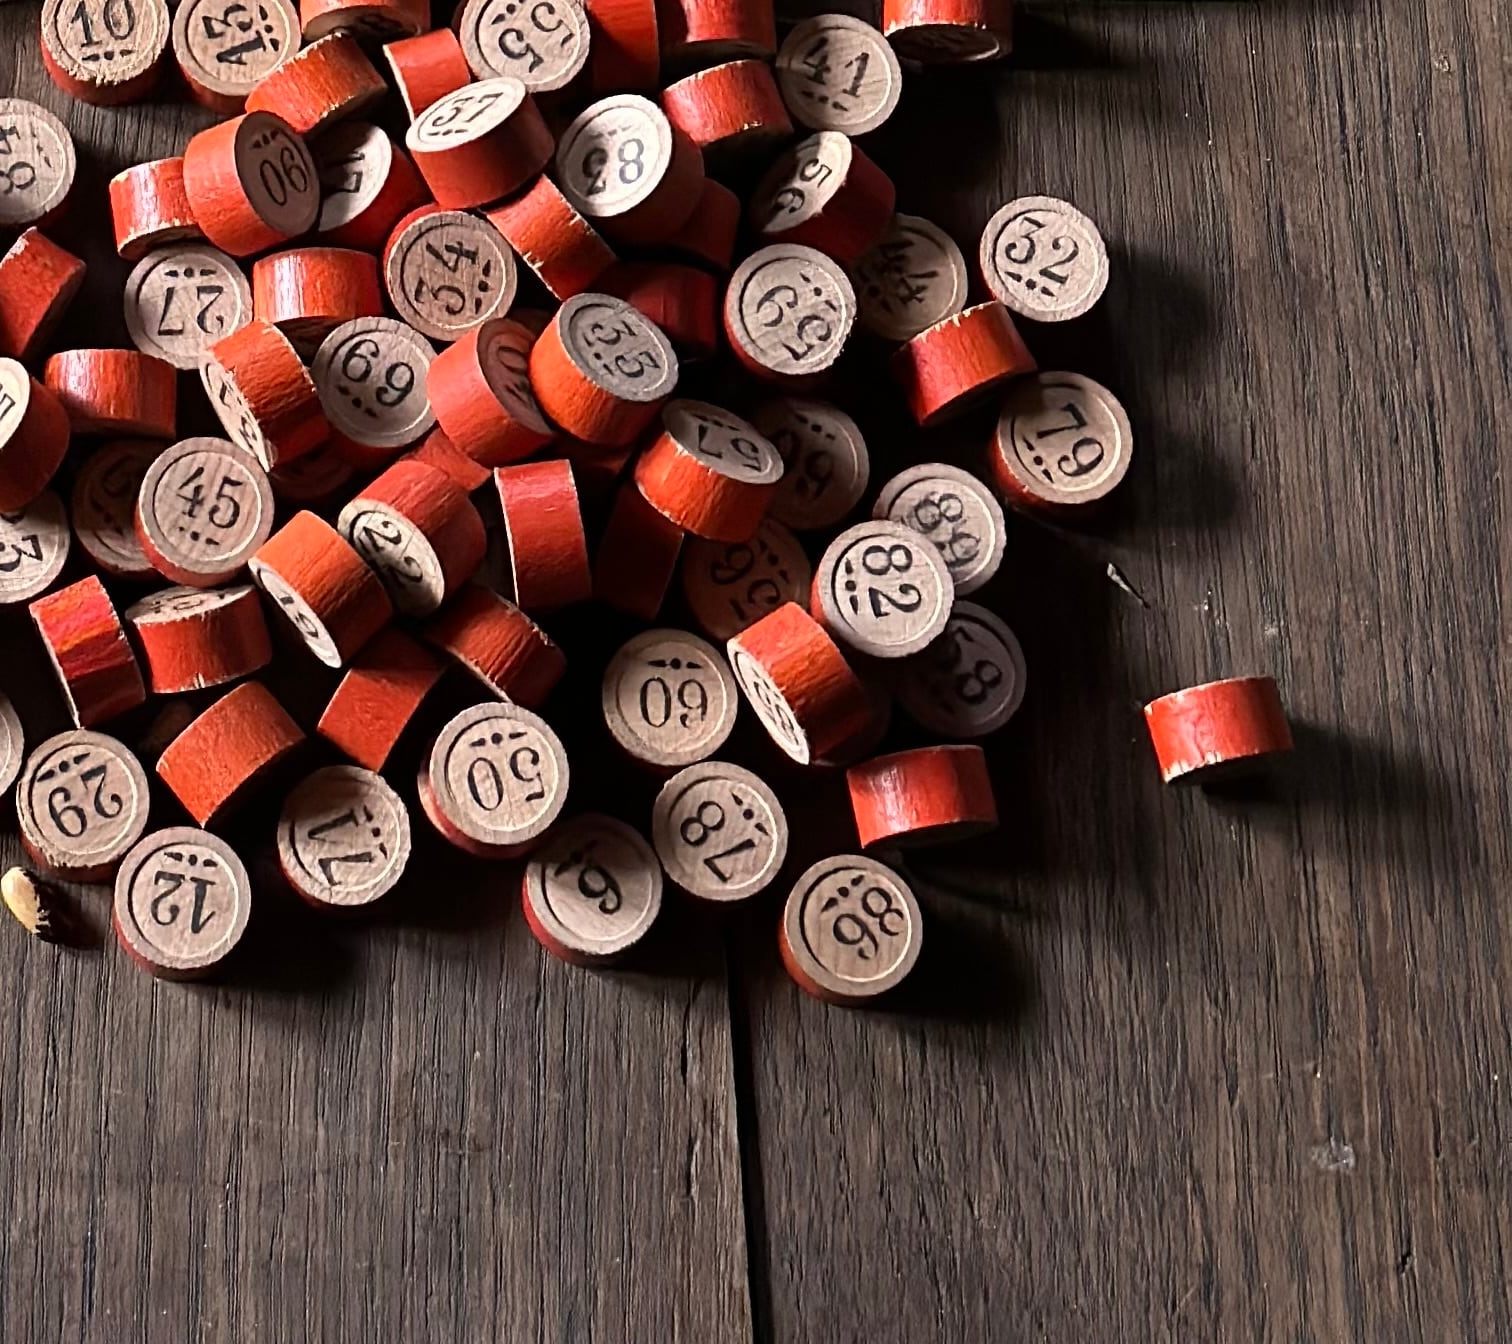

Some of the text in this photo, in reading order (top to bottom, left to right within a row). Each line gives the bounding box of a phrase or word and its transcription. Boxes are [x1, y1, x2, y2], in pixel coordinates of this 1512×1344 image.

[202, 2, 264, 65] 13
[497, 1, 575, 73] 55
[802, 36, 869, 97] 41
[583, 138, 644, 197] 83
[413, 240, 481, 314] 34
[1004, 217, 1079, 284] 32
[157, 284, 224, 337] 27
[756, 286, 831, 361] 59
[341, 339, 415, 407] 69
[699, 424, 761, 472] 57
[1038, 403, 1105, 478] 79
[176, 466, 244, 529] 45
[363, 521, 423, 584] 22
[861, 543, 923, 620] 82
[638, 676, 708, 729] 60
[48, 765, 123, 837] 29
[467, 747, 546, 811] 50
[307, 808, 373, 886] 71
[679, 801, 757, 884] 78
[150, 870, 219, 935] 12
[580, 864, 623, 915] 6
[833, 888, 905, 961] 86
